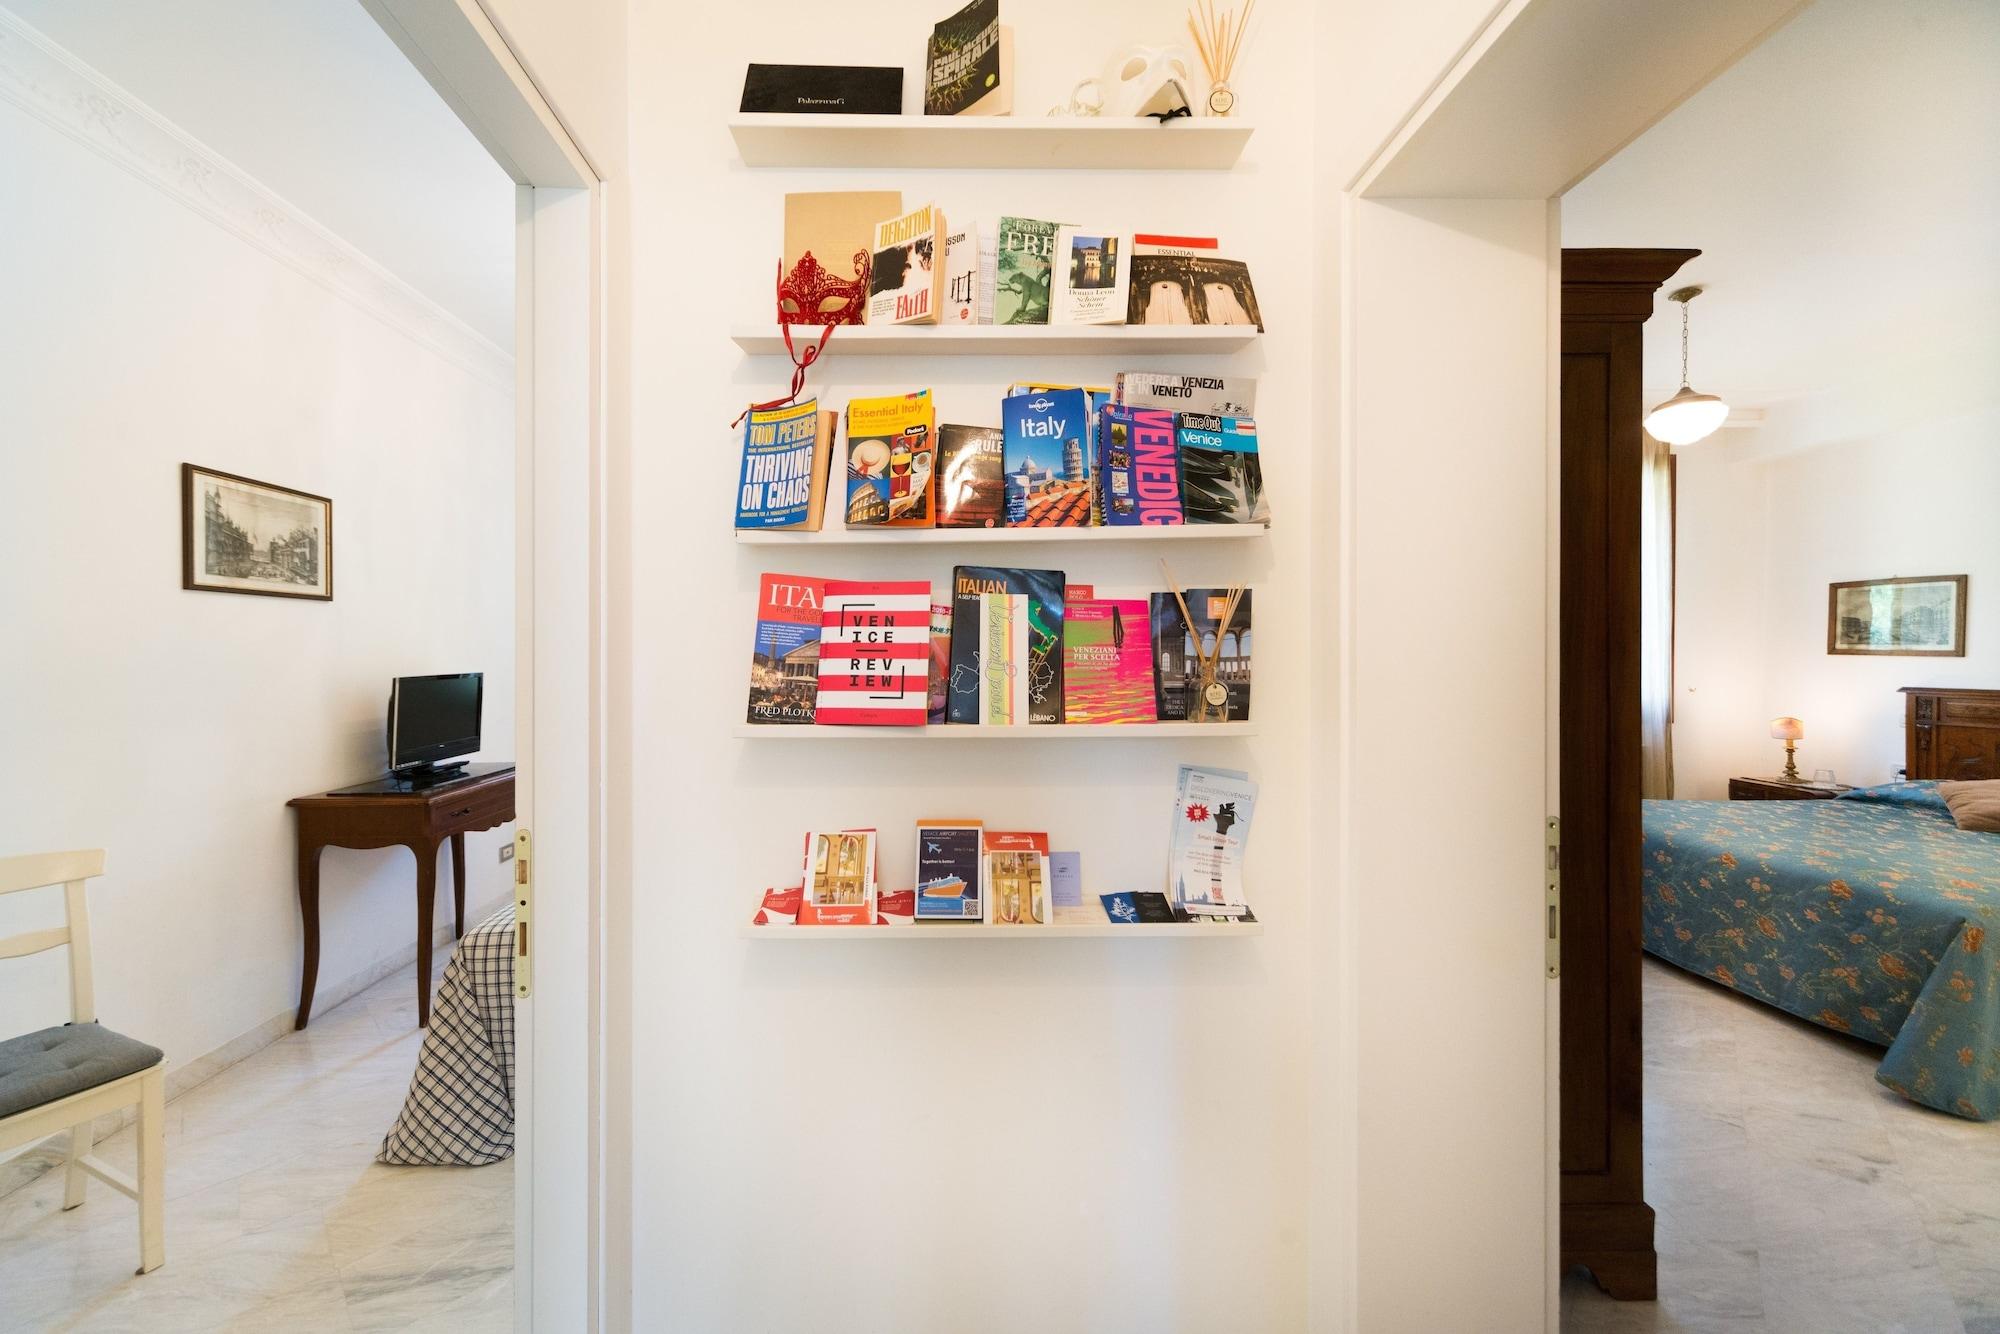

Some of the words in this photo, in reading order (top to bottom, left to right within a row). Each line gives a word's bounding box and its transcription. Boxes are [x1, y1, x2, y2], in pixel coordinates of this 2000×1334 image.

[932, 29, 999, 82] SPIRALE
[933, 50, 961, 68] PAUL
[880, 205, 931, 247] DEIGHTON
[1157, 248, 1195, 256] ESSENTIAL
[1181, 376, 1224, 390] VENEZIA
[1152, 385, 1193, 398] VENETO
[853, 406, 898, 418] Essential
[901, 401, 924, 415] Italy
[749, 424, 776, 446] TOM
[777, 414, 817, 444] PETERS
[1020, 415, 1066, 439] Italy
[1181, 413, 1204, 429] Time
[1204, 416, 1222, 432] Out
[975, 438, 1004, 454] RULE
[1181, 430, 1222, 446] Venice
[745, 446, 813, 483] THRIVING
[1133, 410, 1184, 526] VENEDIG
[741, 483, 763, 510] ON
[767, 475, 810, 509] CHAOS
[957, 576, 1007, 595] ITALIAN
[853, 615, 895, 627] VEN
[852, 631, 893, 643] ICE
[1073, 646, 1117, 654] VENEZIANI
[1073, 653, 1088, 661] PER
[850, 658, 893, 671] REV
[849, 675, 892, 687] IEW
[755, 705, 780, 718] FRED
